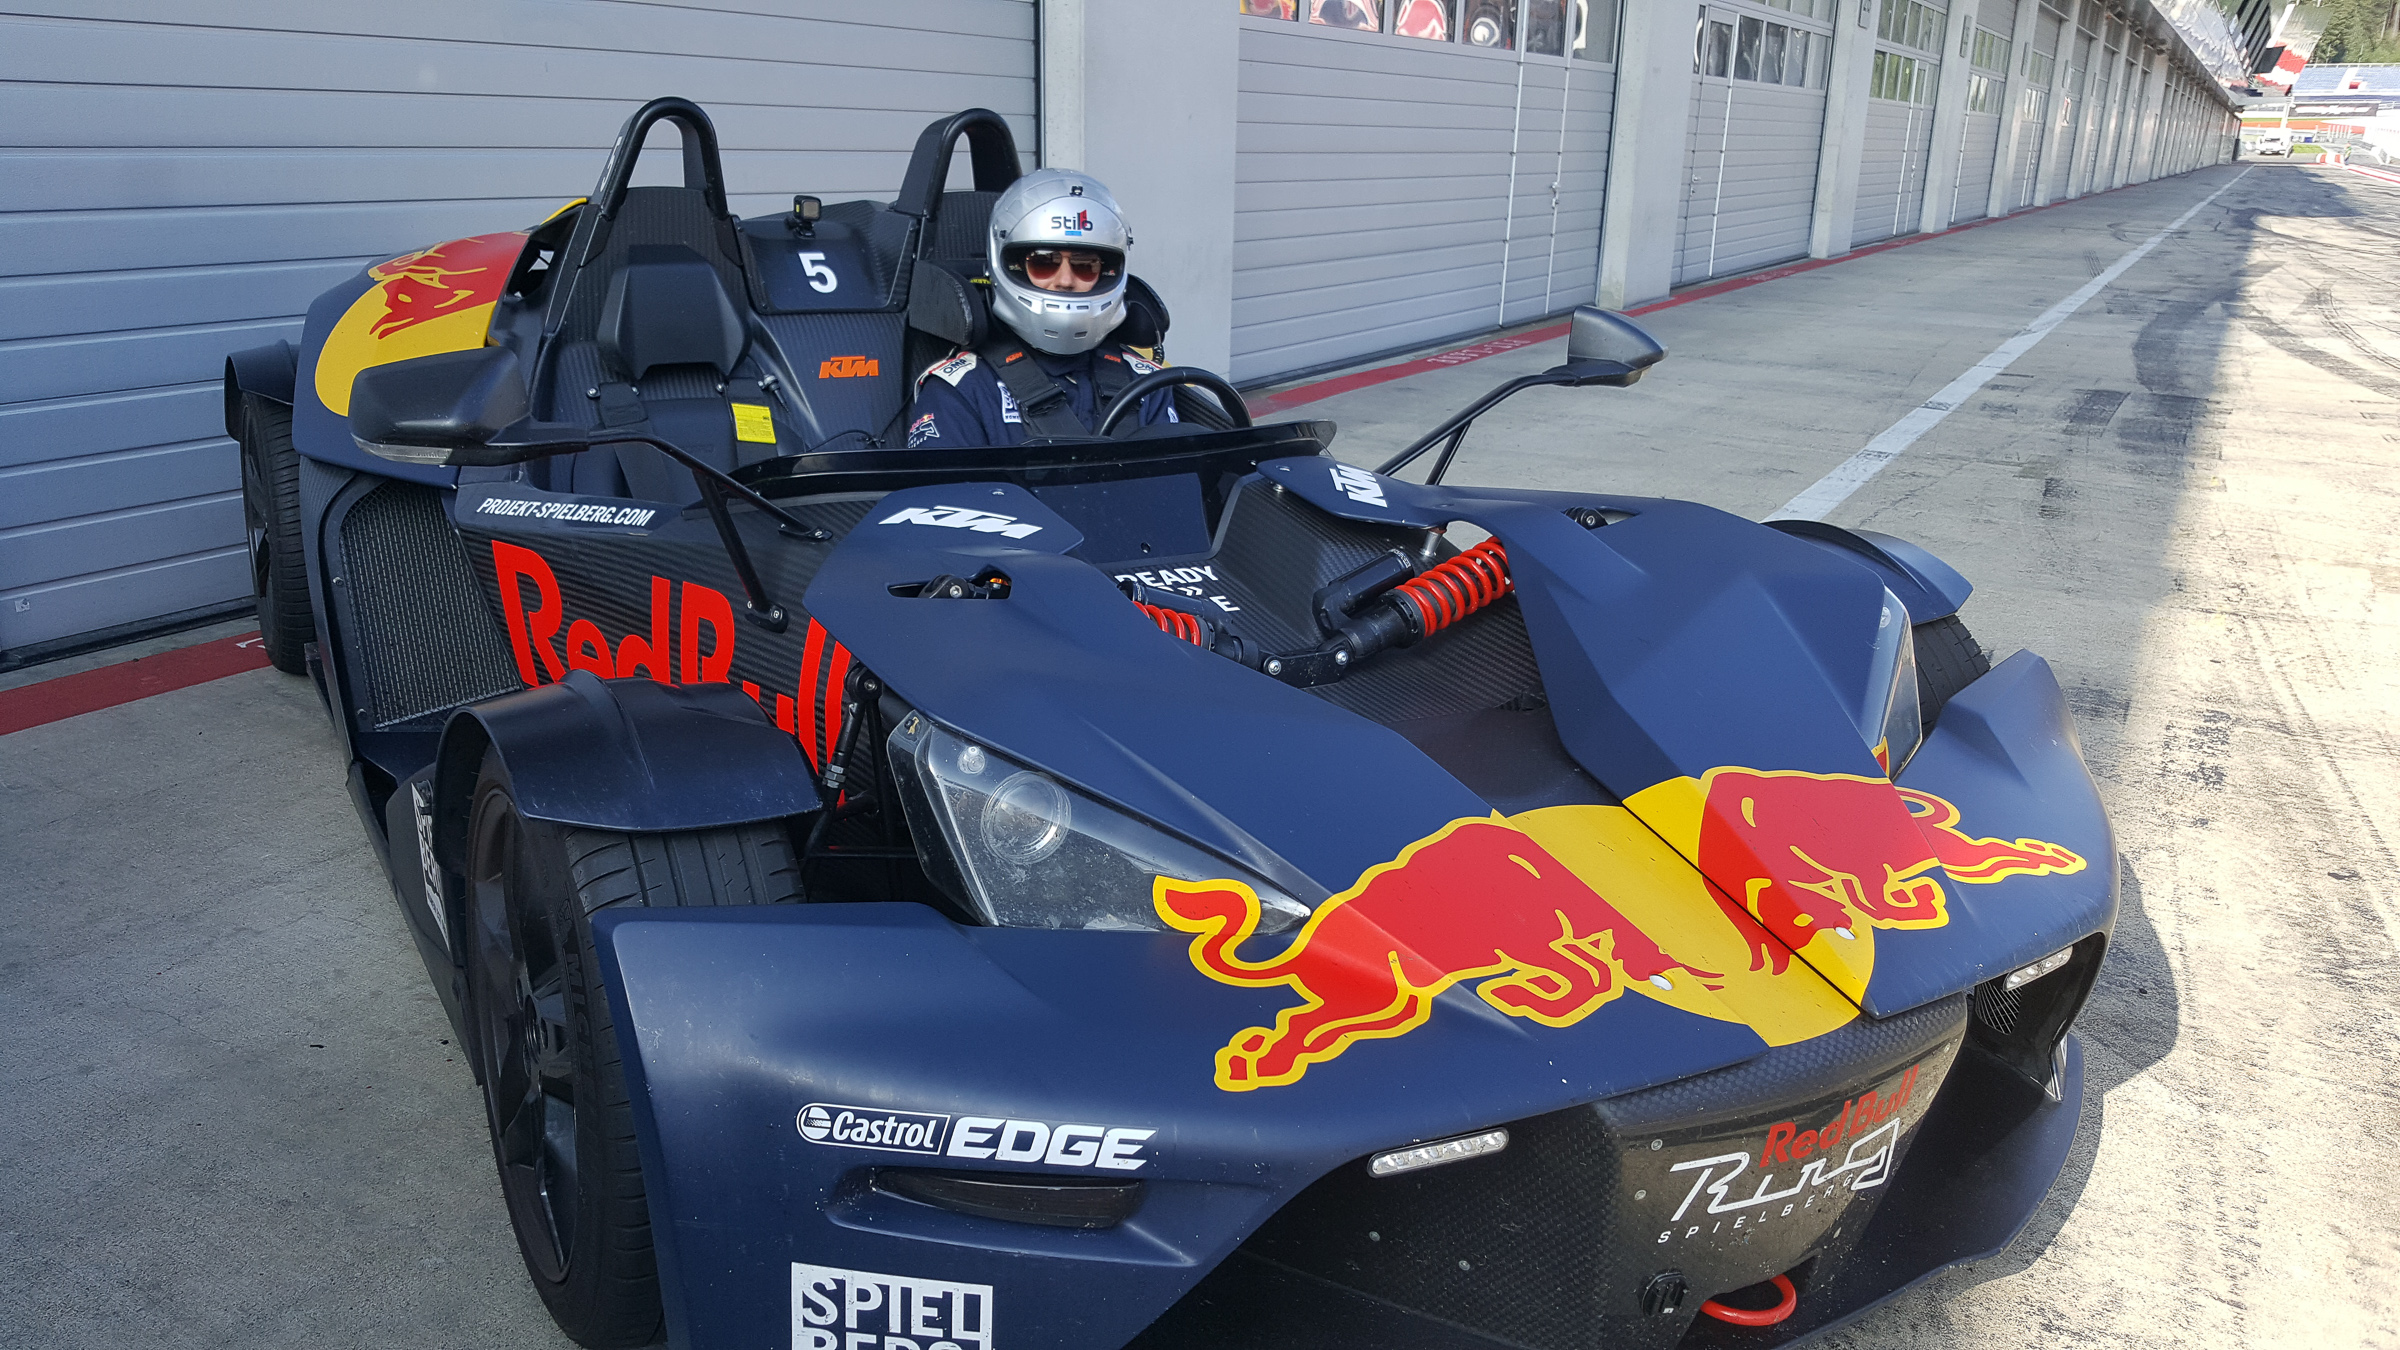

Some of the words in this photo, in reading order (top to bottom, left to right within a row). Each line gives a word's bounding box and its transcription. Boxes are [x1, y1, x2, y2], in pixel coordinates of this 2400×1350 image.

[1051, 211, 1094, 231] Stilo
[799, 252, 838, 294] 5
[819, 355, 880, 379] KTM
[943, 358, 967, 374] OMP
[1329, 464, 1388, 508] KTM
[476, 498, 656, 527] PROJEKT-SPIELBERG.COM
[878, 505, 1043, 540] KTM
[1759, 1099, 1852, 1168] Red
[1849, 1064, 1919, 1138] Bull
[832, 1111, 937, 1148] Castrol
[947, 1116, 1157, 1171] EDGE
[1669, 1117, 1900, 1222] Ring
[1657, 1173, 1854, 1244] SPIELBERG
[802, 1277, 983, 1341] SPIEL
